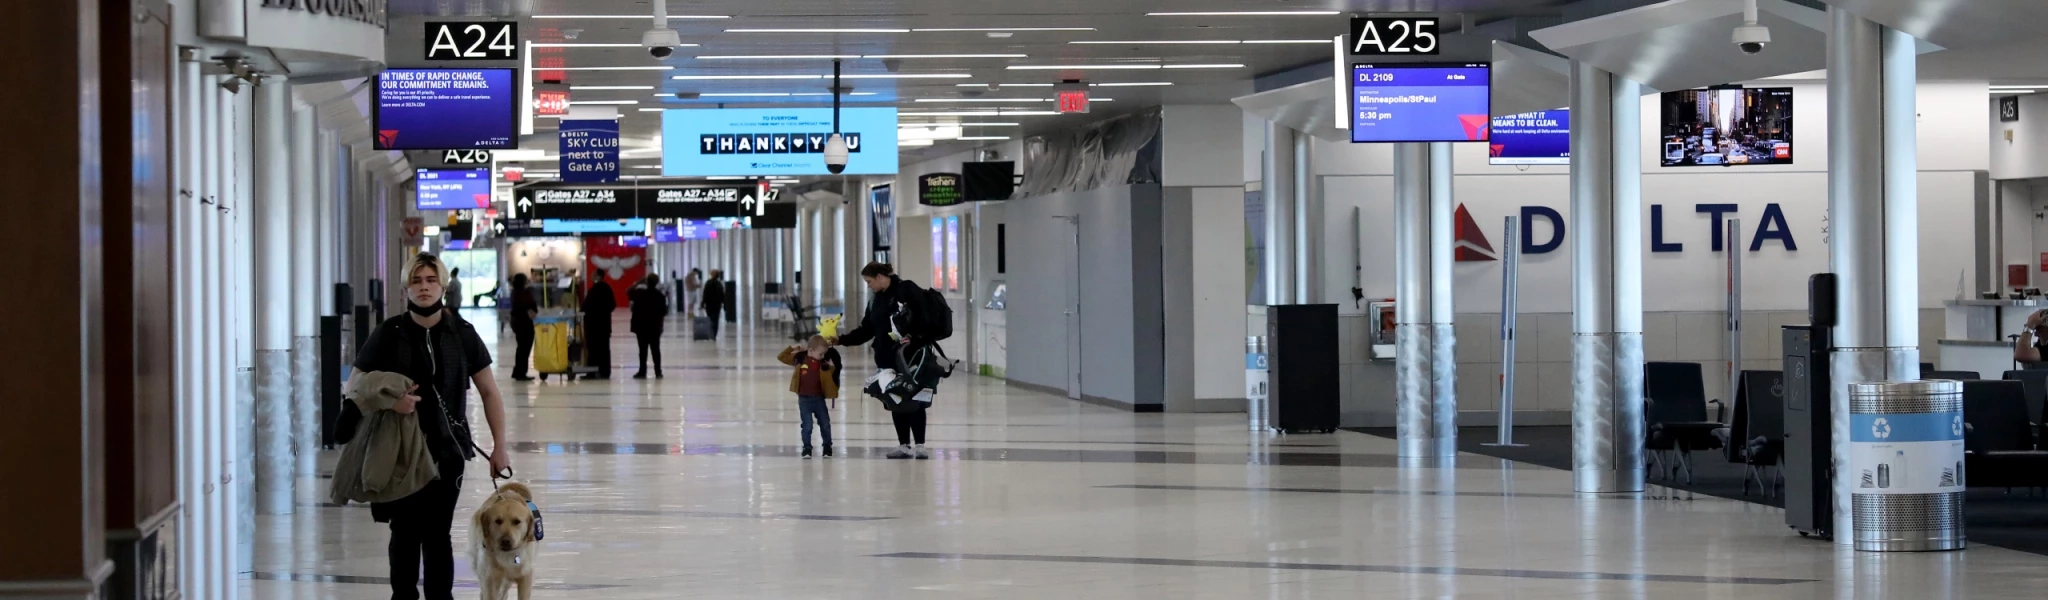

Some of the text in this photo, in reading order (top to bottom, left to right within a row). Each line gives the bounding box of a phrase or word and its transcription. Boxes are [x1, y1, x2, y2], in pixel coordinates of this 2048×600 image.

[428, 24, 515, 57] A24
[1355, 20, 1436, 52] A25
[381, 72, 484, 81] IN TIMES OF RAPID CHANGE,
[1360, 73, 1394, 82] DL 2109
[381, 81, 489, 89] OUR COMMITMENT REMAINS.
[1060, 93, 1084, 111] EXIT
[1360, 95, 1437, 104] Minneapolis/StPaul
[2002, 101, 2014, 118] A25
[567, 138, 618, 147] SKY CLUB
[703, 136, 858, 151] THANK YU
[444, 150, 489, 163] A26
[568, 151, 604, 159] next to
[568, 162, 615, 171] Gate A19
[547, 190, 571, 198] Gates
[573, 190, 590, 198] A27
[597, 190, 614, 198] A34
[658, 189, 682, 197] Gates
[684, 189, 701, 197] A27
[707, 189, 725, 197] A34
[1520, 202, 1798, 255] DLTA
